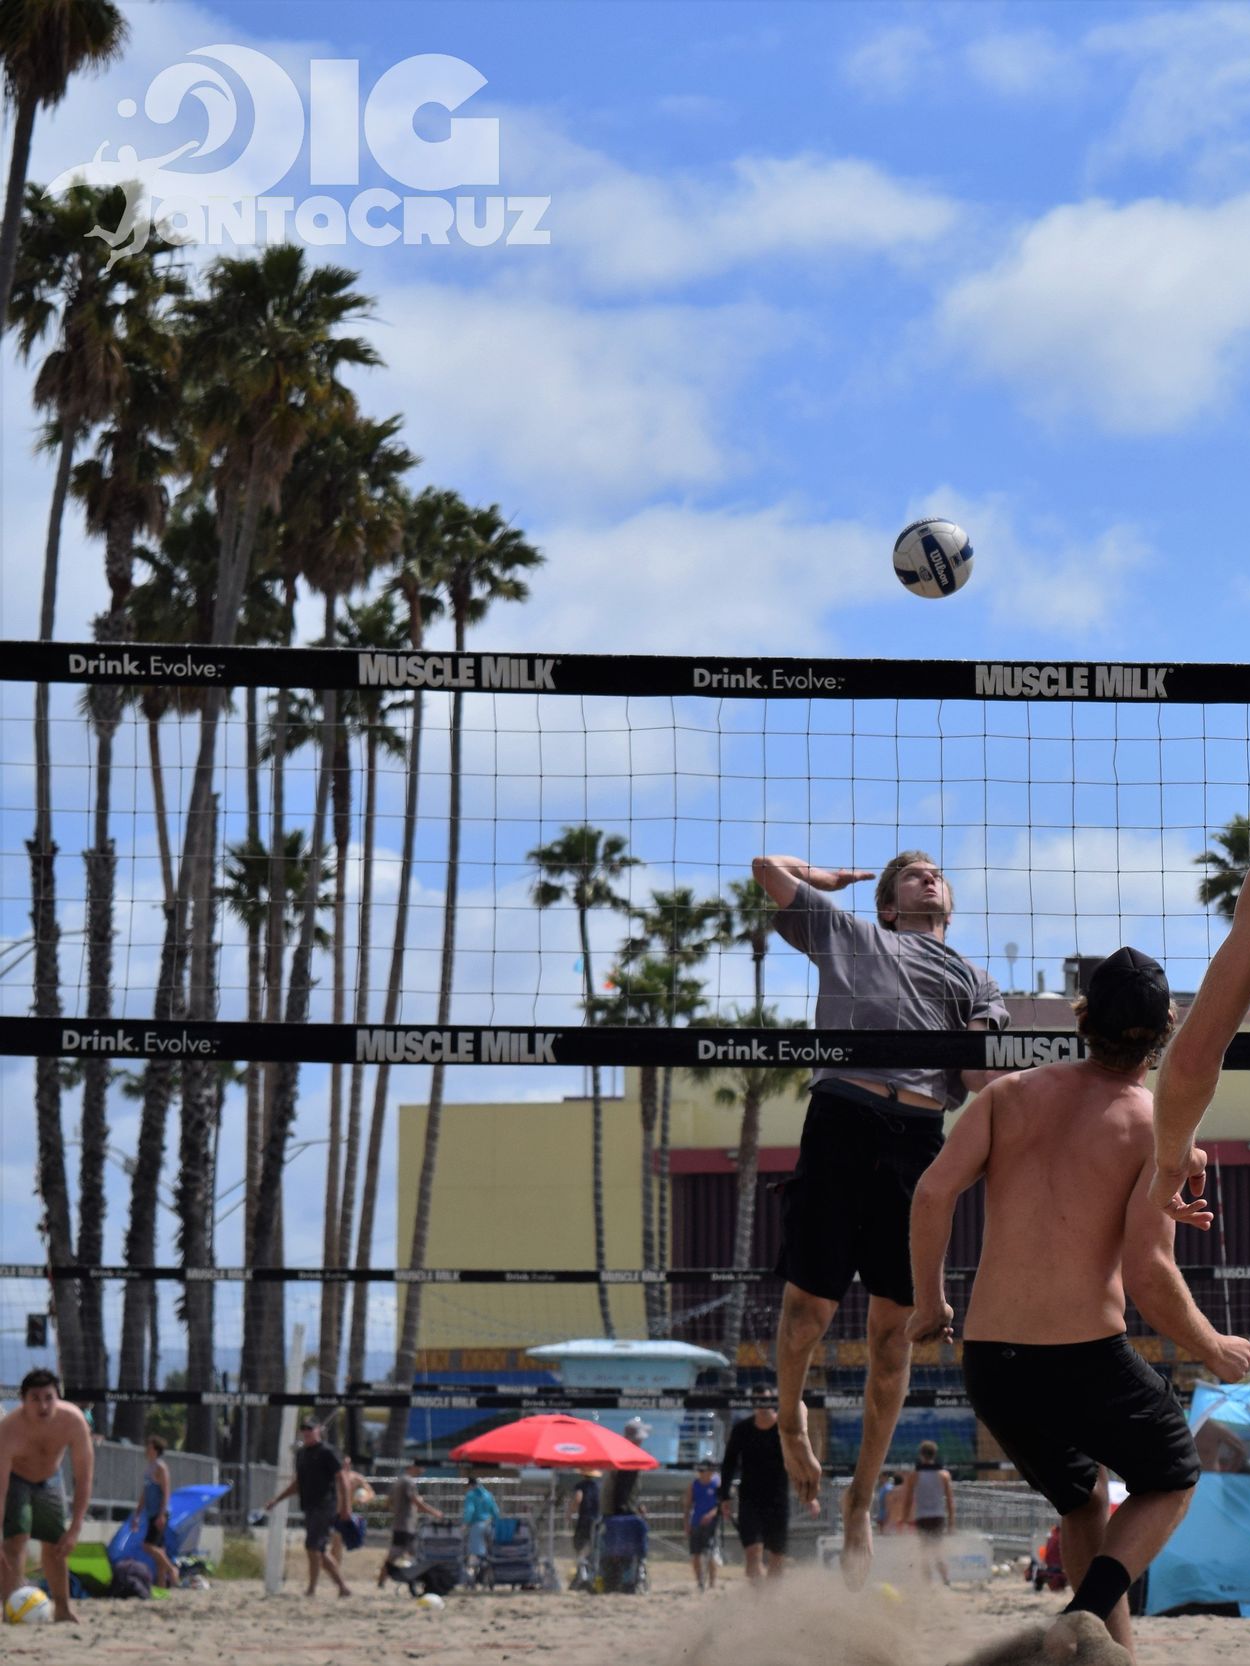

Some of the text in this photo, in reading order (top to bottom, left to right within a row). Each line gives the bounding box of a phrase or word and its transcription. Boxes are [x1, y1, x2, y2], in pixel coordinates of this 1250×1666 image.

[68, 653, 222, 678] Drink. Evolve.
[358, 653, 556, 690] MUSCLE MILK
[693, 667, 842, 690] Drink. Evolve.
[975, 664, 1168, 698] MUSCLE MILK
[62, 1030, 215, 1054] Drink. Evolve.
[356, 1029, 557, 1064] MUSCLE MILK
[698, 1039, 850, 1062] Drink. Evolve.
